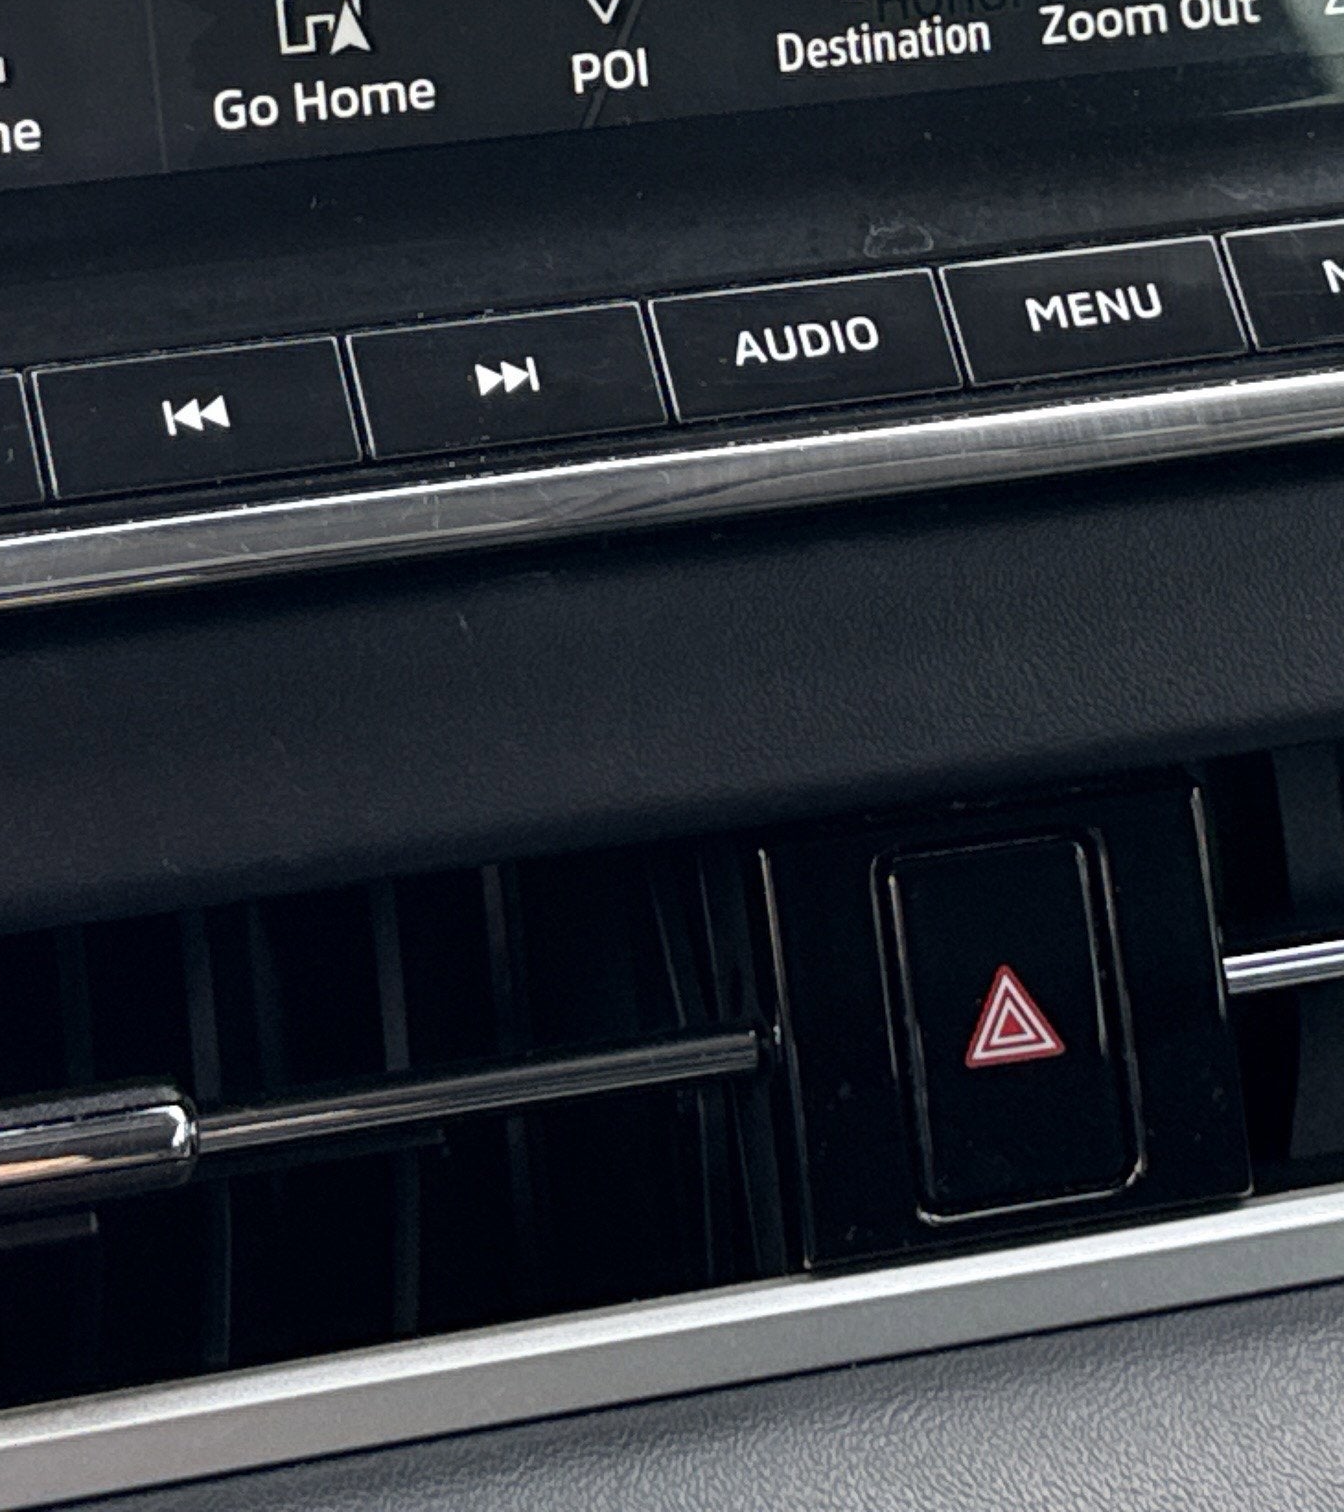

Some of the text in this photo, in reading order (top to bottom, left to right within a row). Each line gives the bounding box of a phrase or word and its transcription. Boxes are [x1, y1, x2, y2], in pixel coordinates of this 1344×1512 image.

[776, 14, 992, 74] Destination
[1038, 1, 1169, 46] Zoom
[571, 46, 650, 95] POI
[213, 75, 437, 132] Go Home
[1024, 283, 1163, 333] MENU
[734, 315, 880, 367] AUDIO
